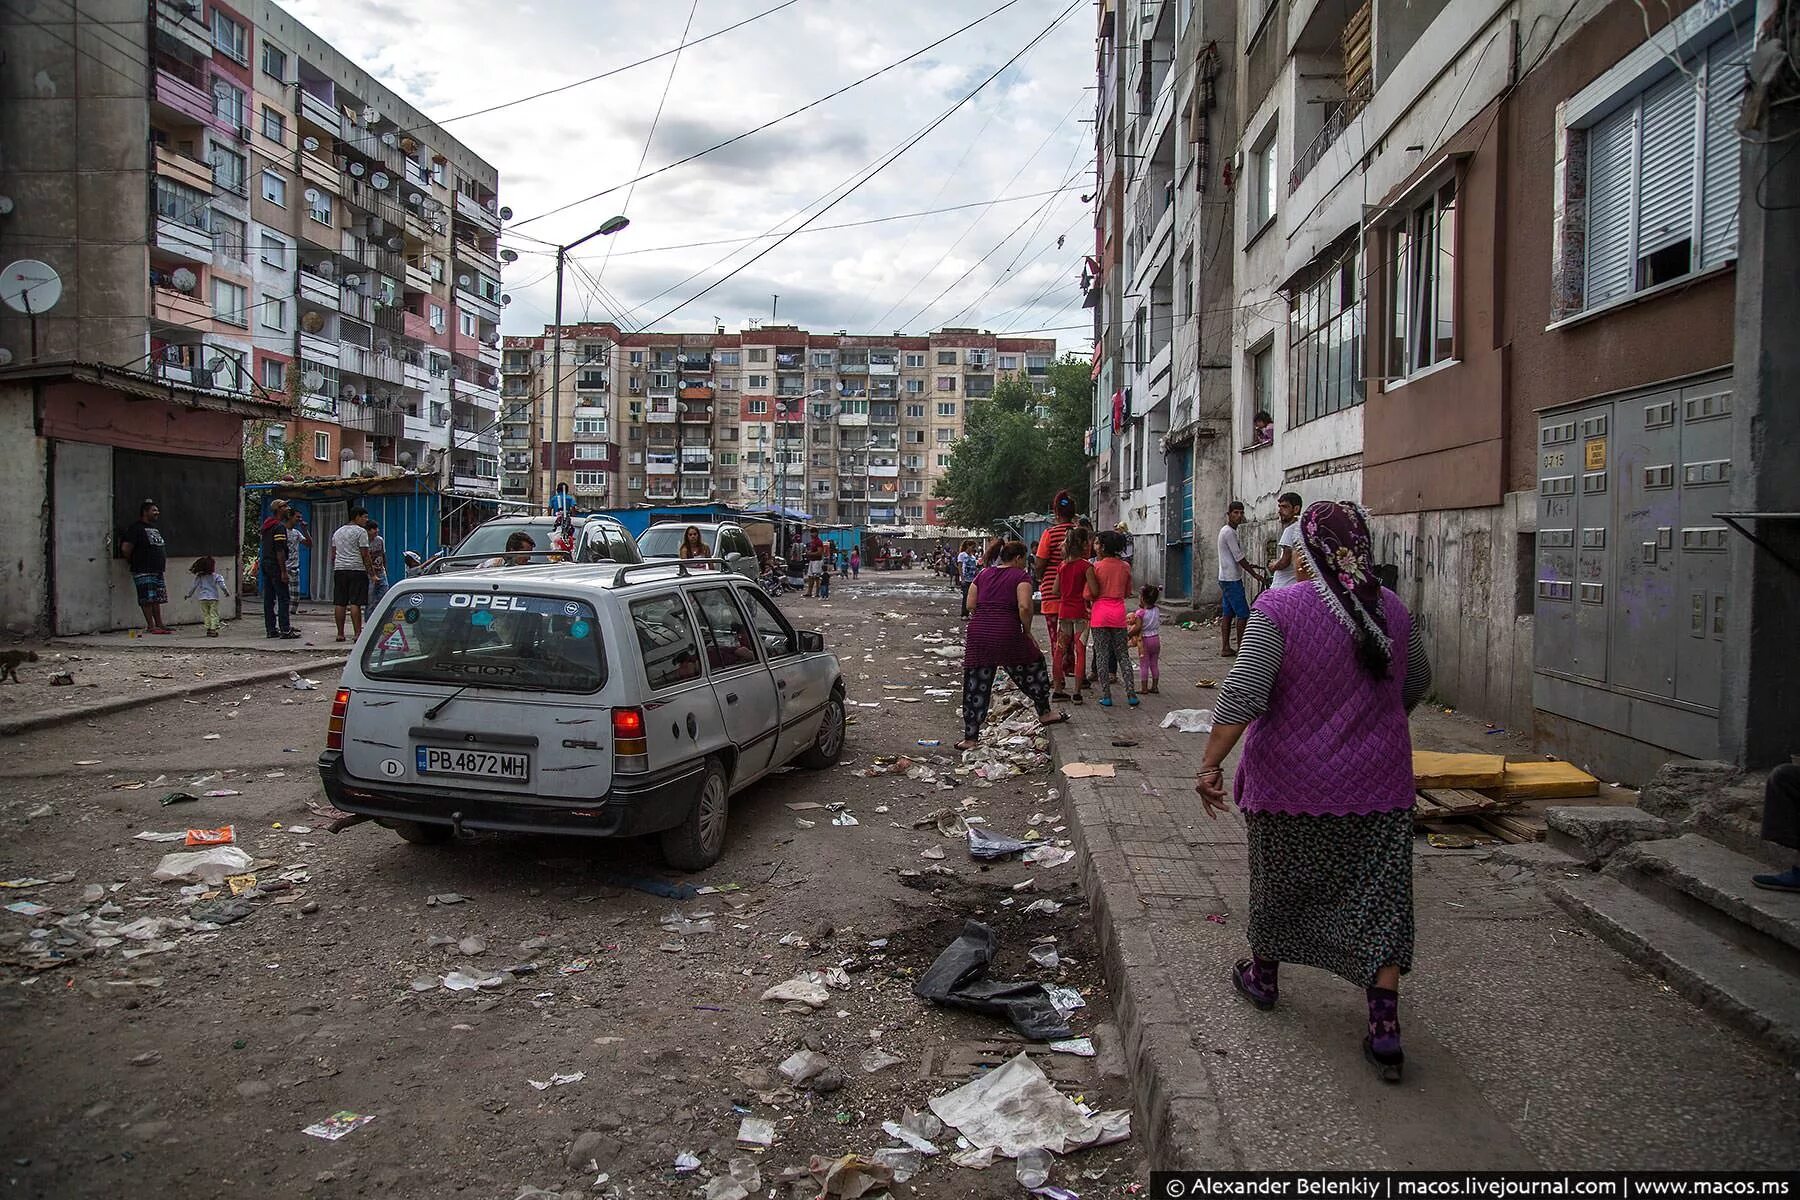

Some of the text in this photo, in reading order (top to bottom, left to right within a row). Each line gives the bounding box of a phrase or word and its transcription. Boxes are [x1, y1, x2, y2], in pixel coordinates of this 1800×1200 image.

[449, 593, 527, 611] OPEL
[432, 663, 516, 676] SECTOR
[387, 761, 398, 774] D
